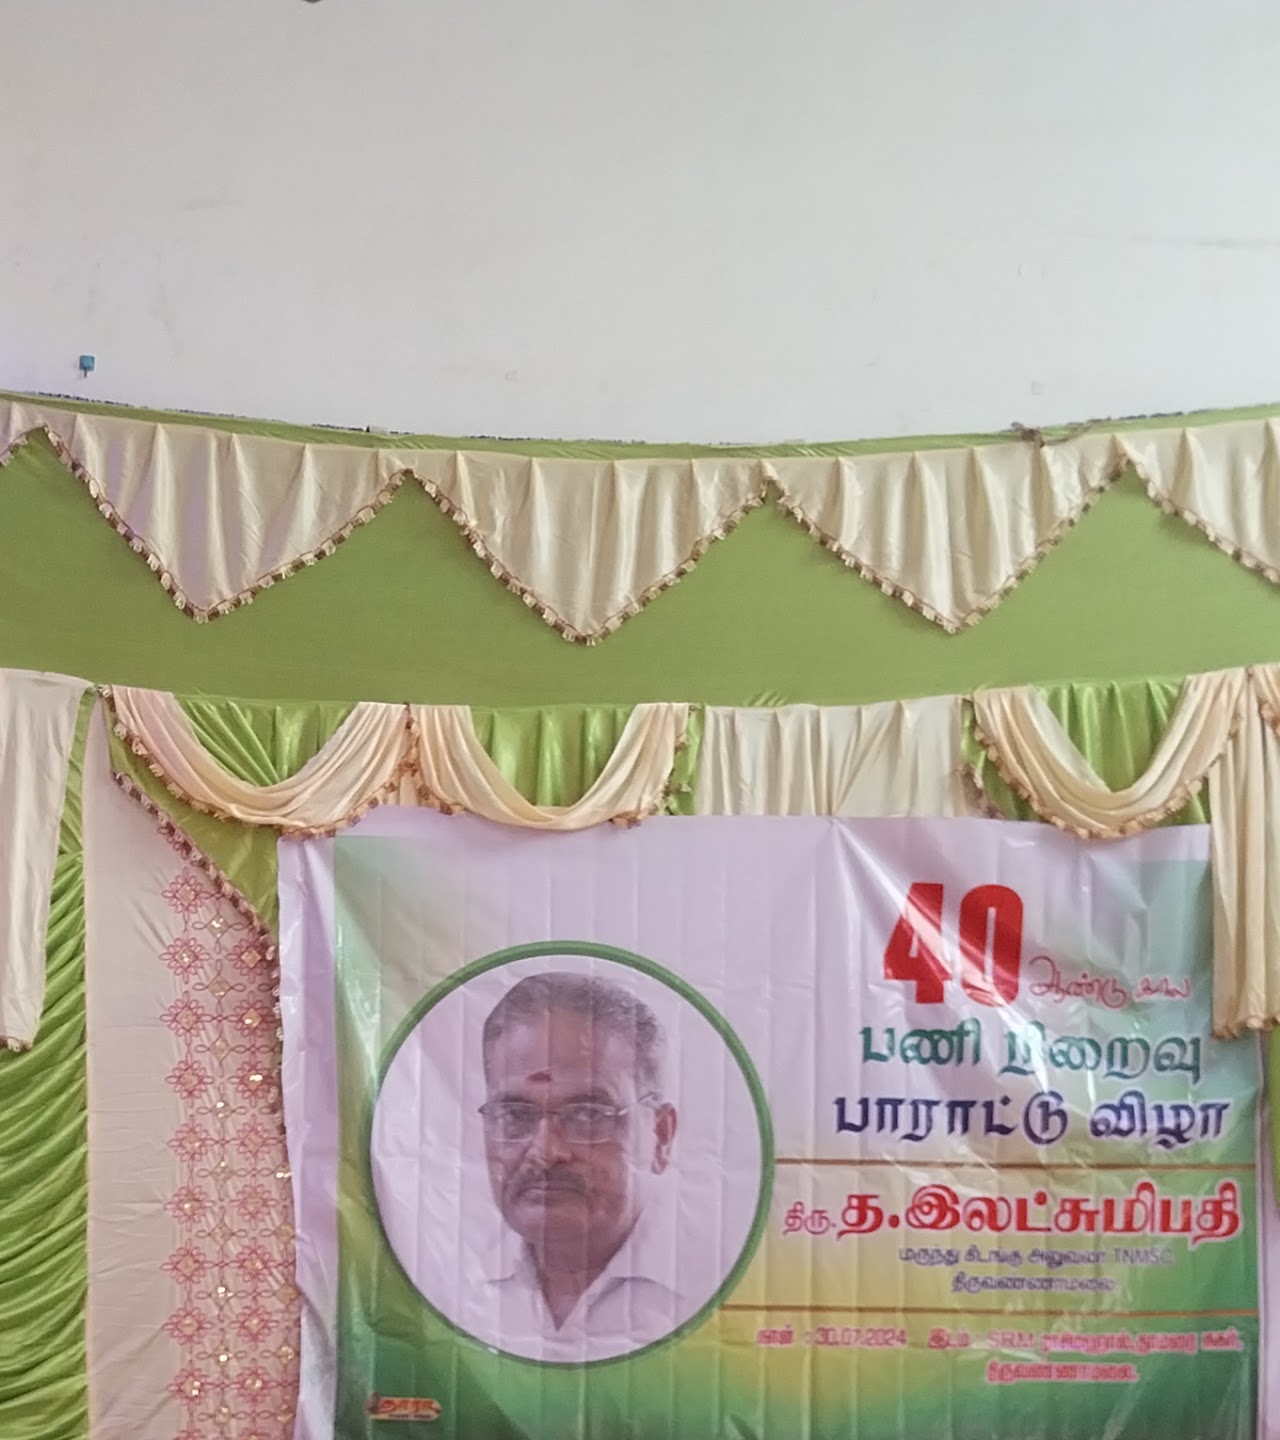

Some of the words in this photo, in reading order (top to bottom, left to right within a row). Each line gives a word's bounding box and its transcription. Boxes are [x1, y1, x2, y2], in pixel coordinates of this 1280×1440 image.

[883, 882, 1024, 1007] 40
[1027, 954, 1128, 1009] ஆண்டு
[860, 1017, 982, 1067] பணி
[833, 1090, 1068, 1144] பாராட்டு
[1089, 1090, 1230, 1149] விழா
[837, 1180, 1241, 1244] த.இலட்சுமிபதி
